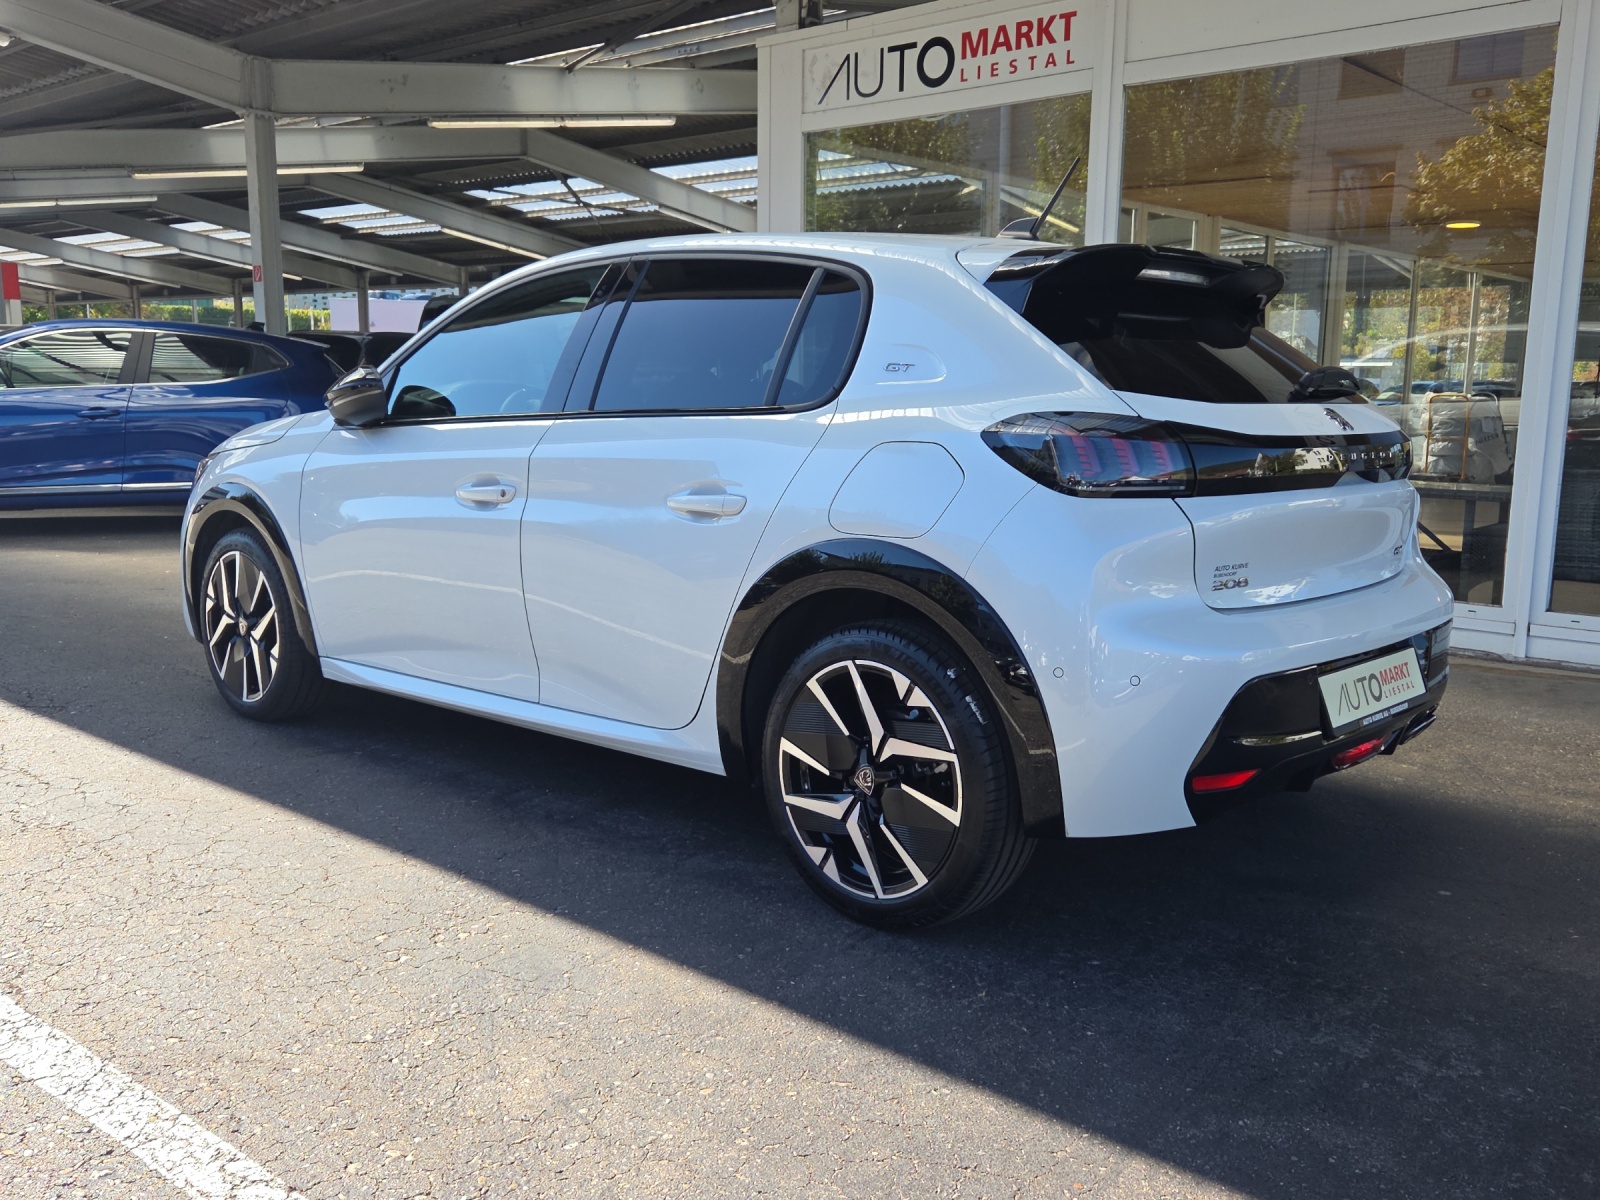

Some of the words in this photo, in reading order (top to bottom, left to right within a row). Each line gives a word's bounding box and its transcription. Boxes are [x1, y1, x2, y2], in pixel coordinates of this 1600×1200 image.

[817, 36, 955, 105] AUTO
[960, 10, 1078, 60] MARKT
[960, 49, 1076, 82] LIESTAL
[883, 362, 916, 373] GT
[1214, 564, 1231, 572] AUTO
[1211, 577, 1249, 592] 208
[1338, 673, 1383, 717] AUTO
[1379, 662, 1411, 687] MARKT
[1383, 683, 1415, 699] LIESTAL
